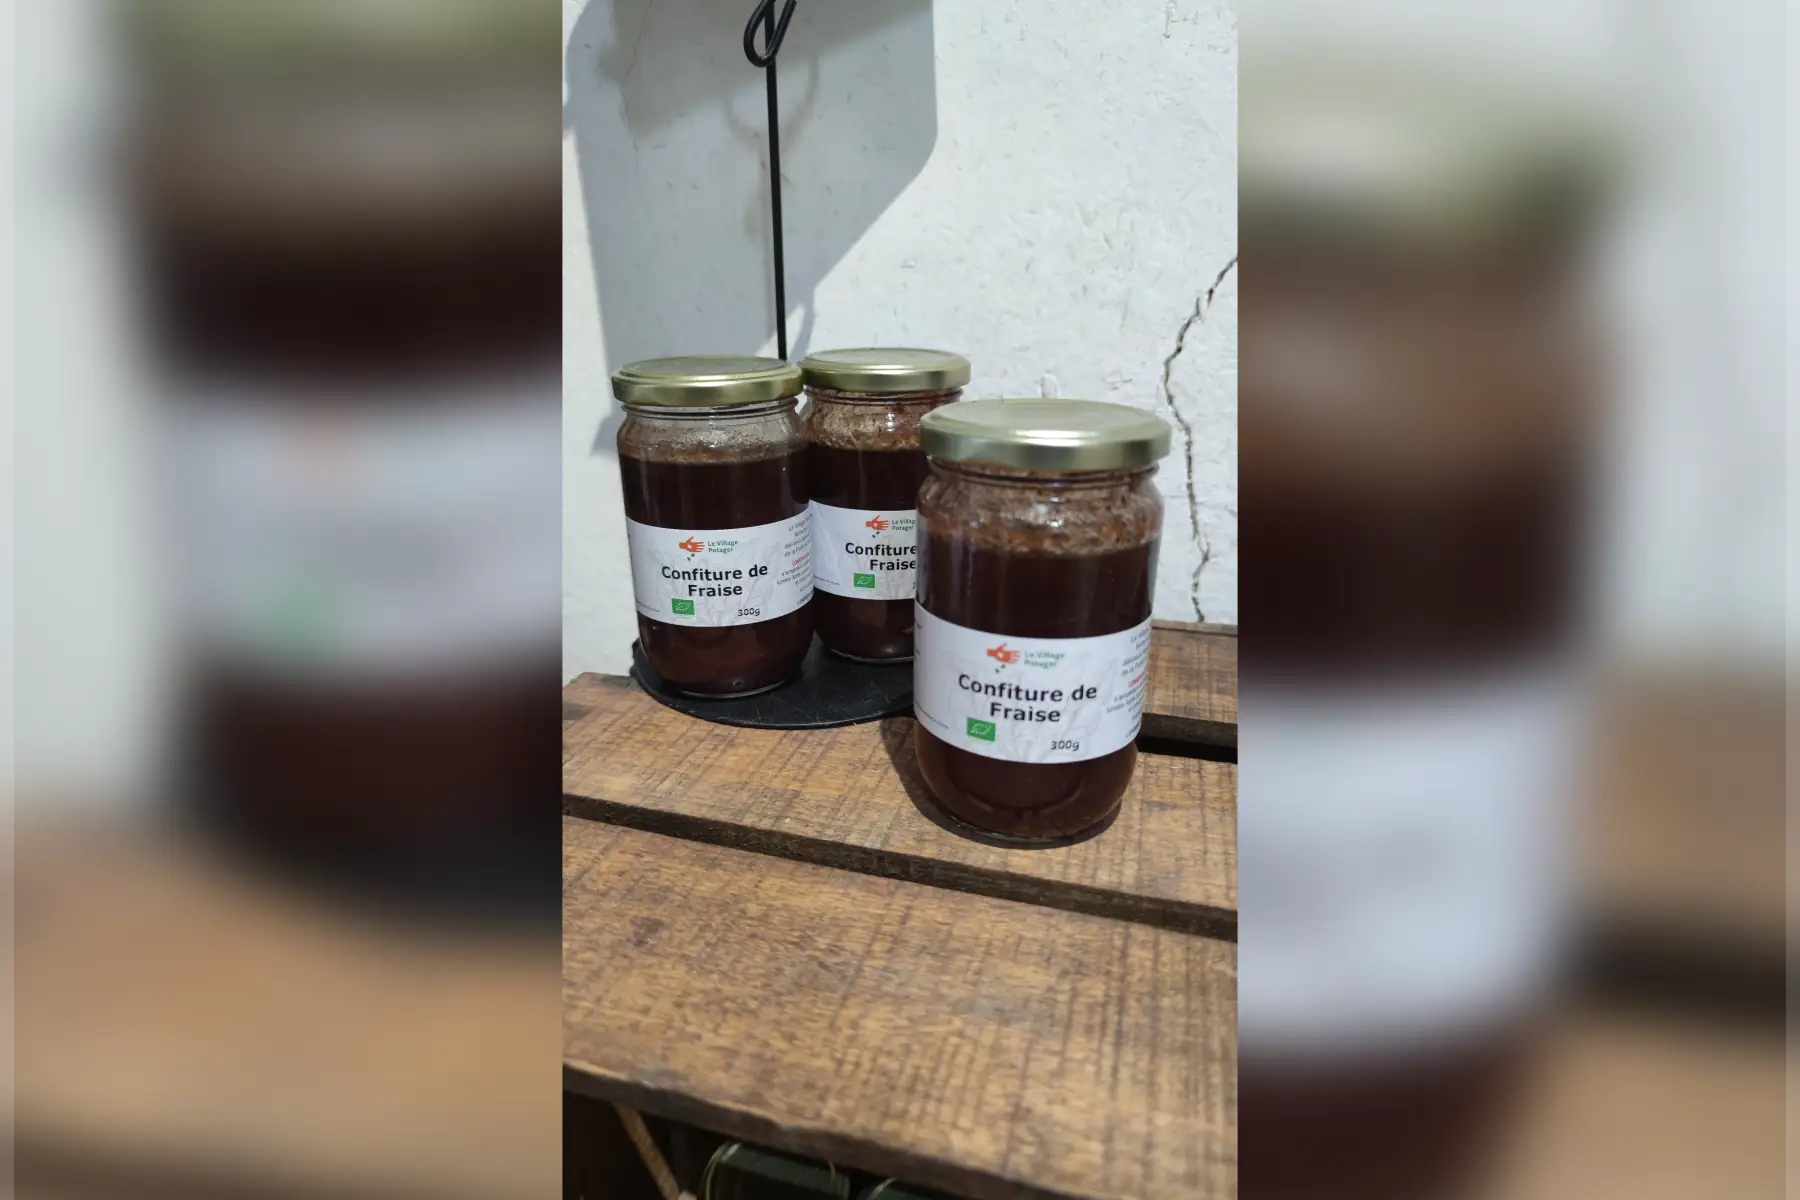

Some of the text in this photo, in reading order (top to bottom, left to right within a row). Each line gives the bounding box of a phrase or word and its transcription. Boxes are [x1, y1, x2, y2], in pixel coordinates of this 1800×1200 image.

[845, 542, 917, 556] Confiture
[870, 559, 917, 571] Fraise
[661, 565, 743, 581] Confiture
[749, 564, 768, 578] de
[688, 583, 743, 597] Fraise
[738, 607, 760, 618] 300g
[958, 674, 1063, 702] Confiture
[1071, 684, 1098, 701] de
[989, 702, 1061, 722] Fraise
[1051, 740, 1080, 752] 300g
